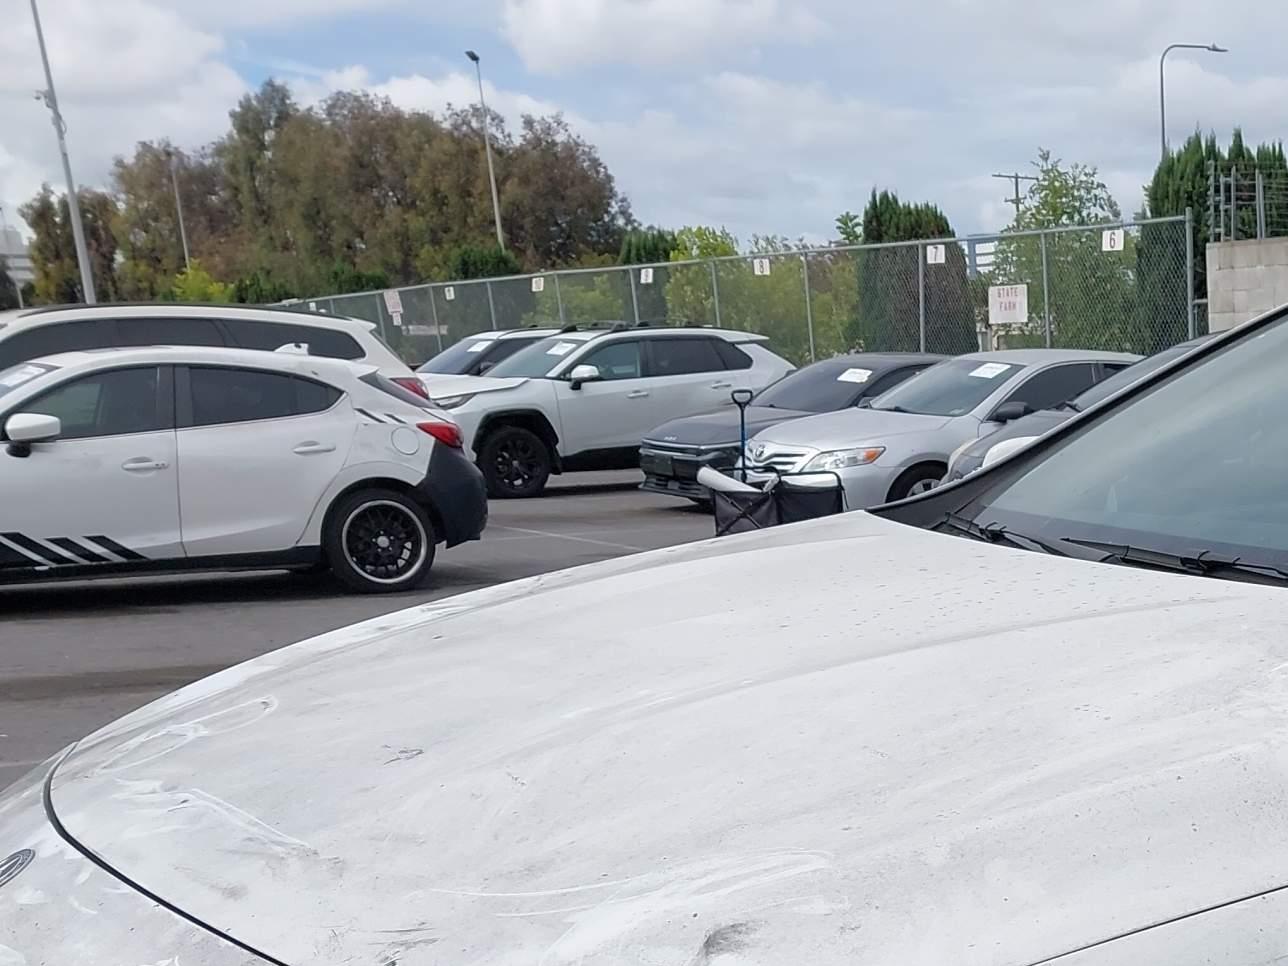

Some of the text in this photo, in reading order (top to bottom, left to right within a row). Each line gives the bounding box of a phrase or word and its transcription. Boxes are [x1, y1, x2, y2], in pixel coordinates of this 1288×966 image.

[1109, 231, 1116, 249] 6
[932, 246, 938, 262] 7
[758, 260, 764, 273] 8
[997, 287, 1018, 298] STATE
[1000, 301, 1017, 311] FARM
